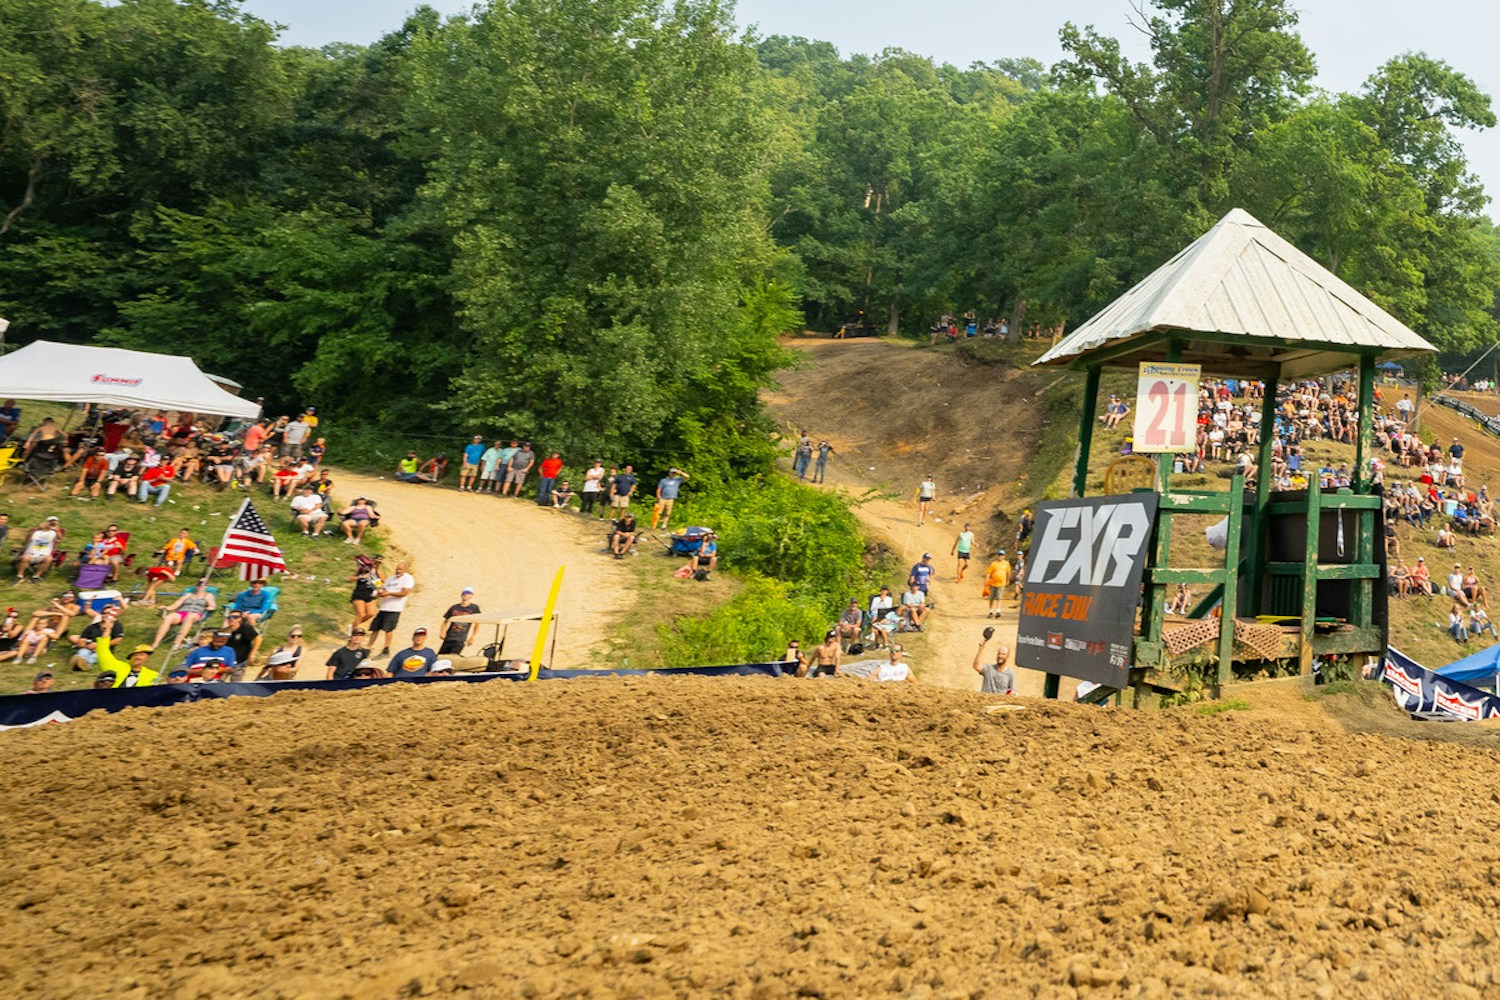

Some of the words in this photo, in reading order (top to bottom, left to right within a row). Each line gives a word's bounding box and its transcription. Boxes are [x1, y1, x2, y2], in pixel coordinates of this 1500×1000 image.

[1144, 380, 1187, 446] 21
[1027, 501, 1150, 587] FXR
[1438, 695, 1478, 718] RACER
